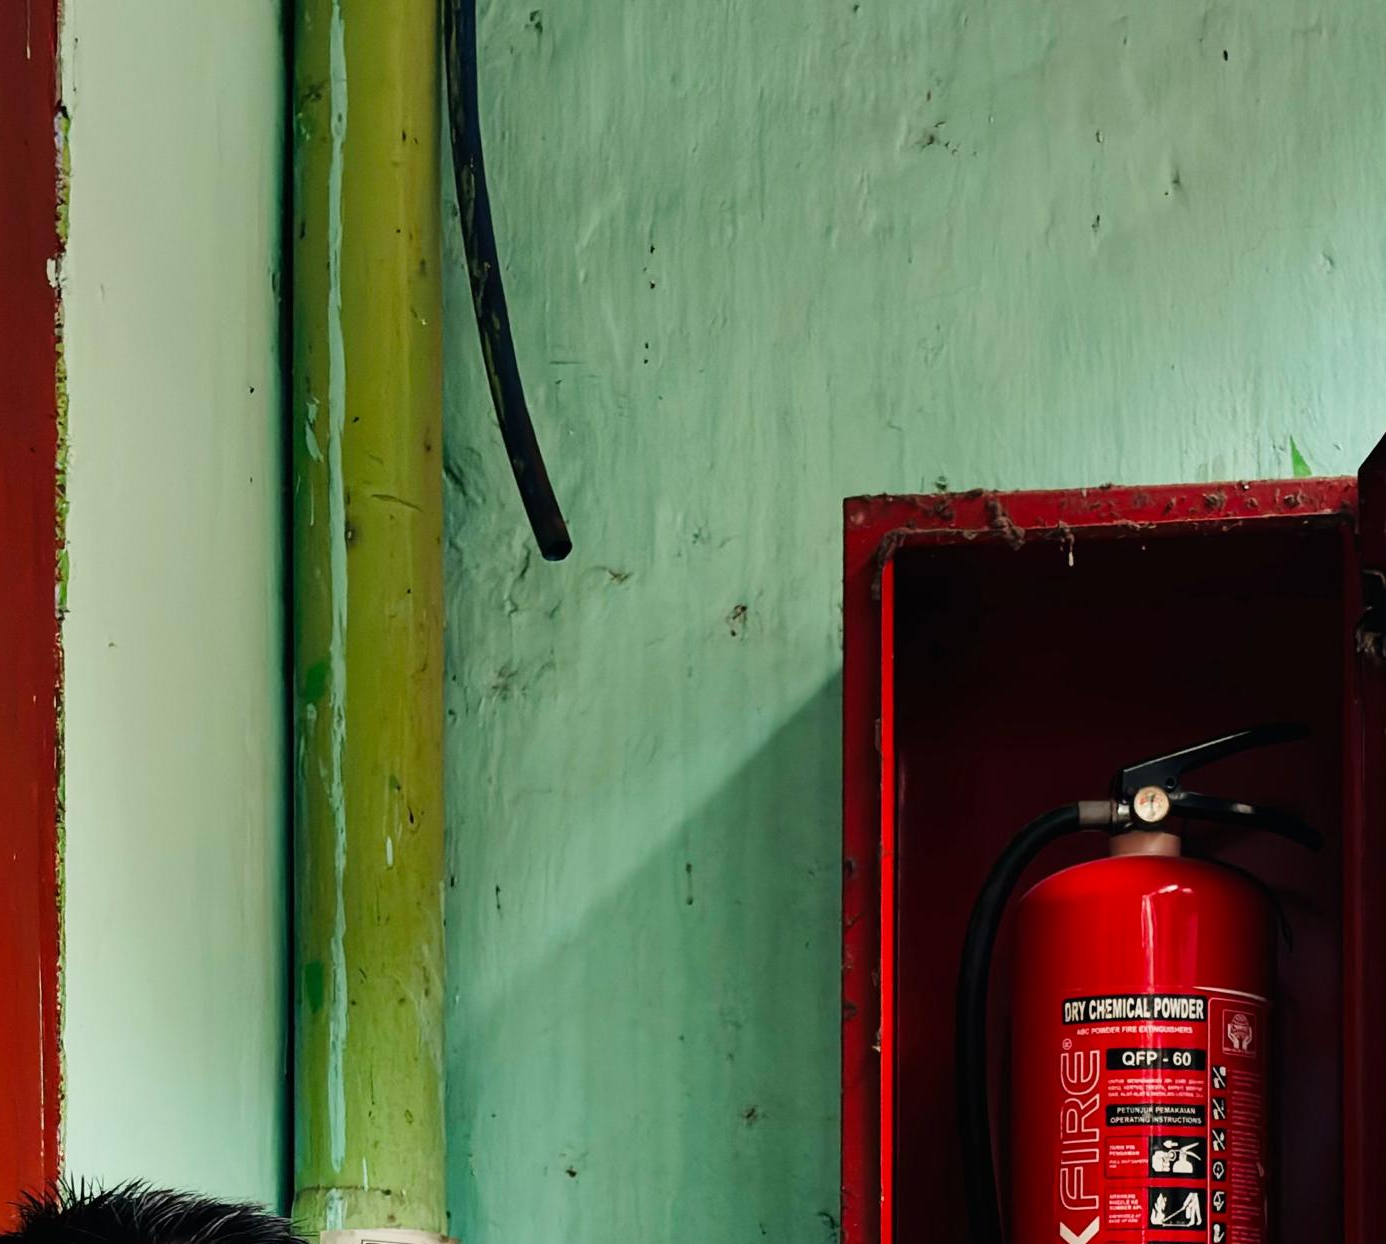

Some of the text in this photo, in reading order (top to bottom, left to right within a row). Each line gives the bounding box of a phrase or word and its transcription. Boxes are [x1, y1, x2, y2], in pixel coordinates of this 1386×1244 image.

[1065, 998, 1204, 1022] DRY CHEMICAL POWDER
[1139, 1026, 1193, 1034] EXTINGUISHERS
[1122, 1051, 1158, 1066] QFP
[1173, 1052, 1192, 1066] 60
[1060, 1049, 1101, 1210] FIRE
